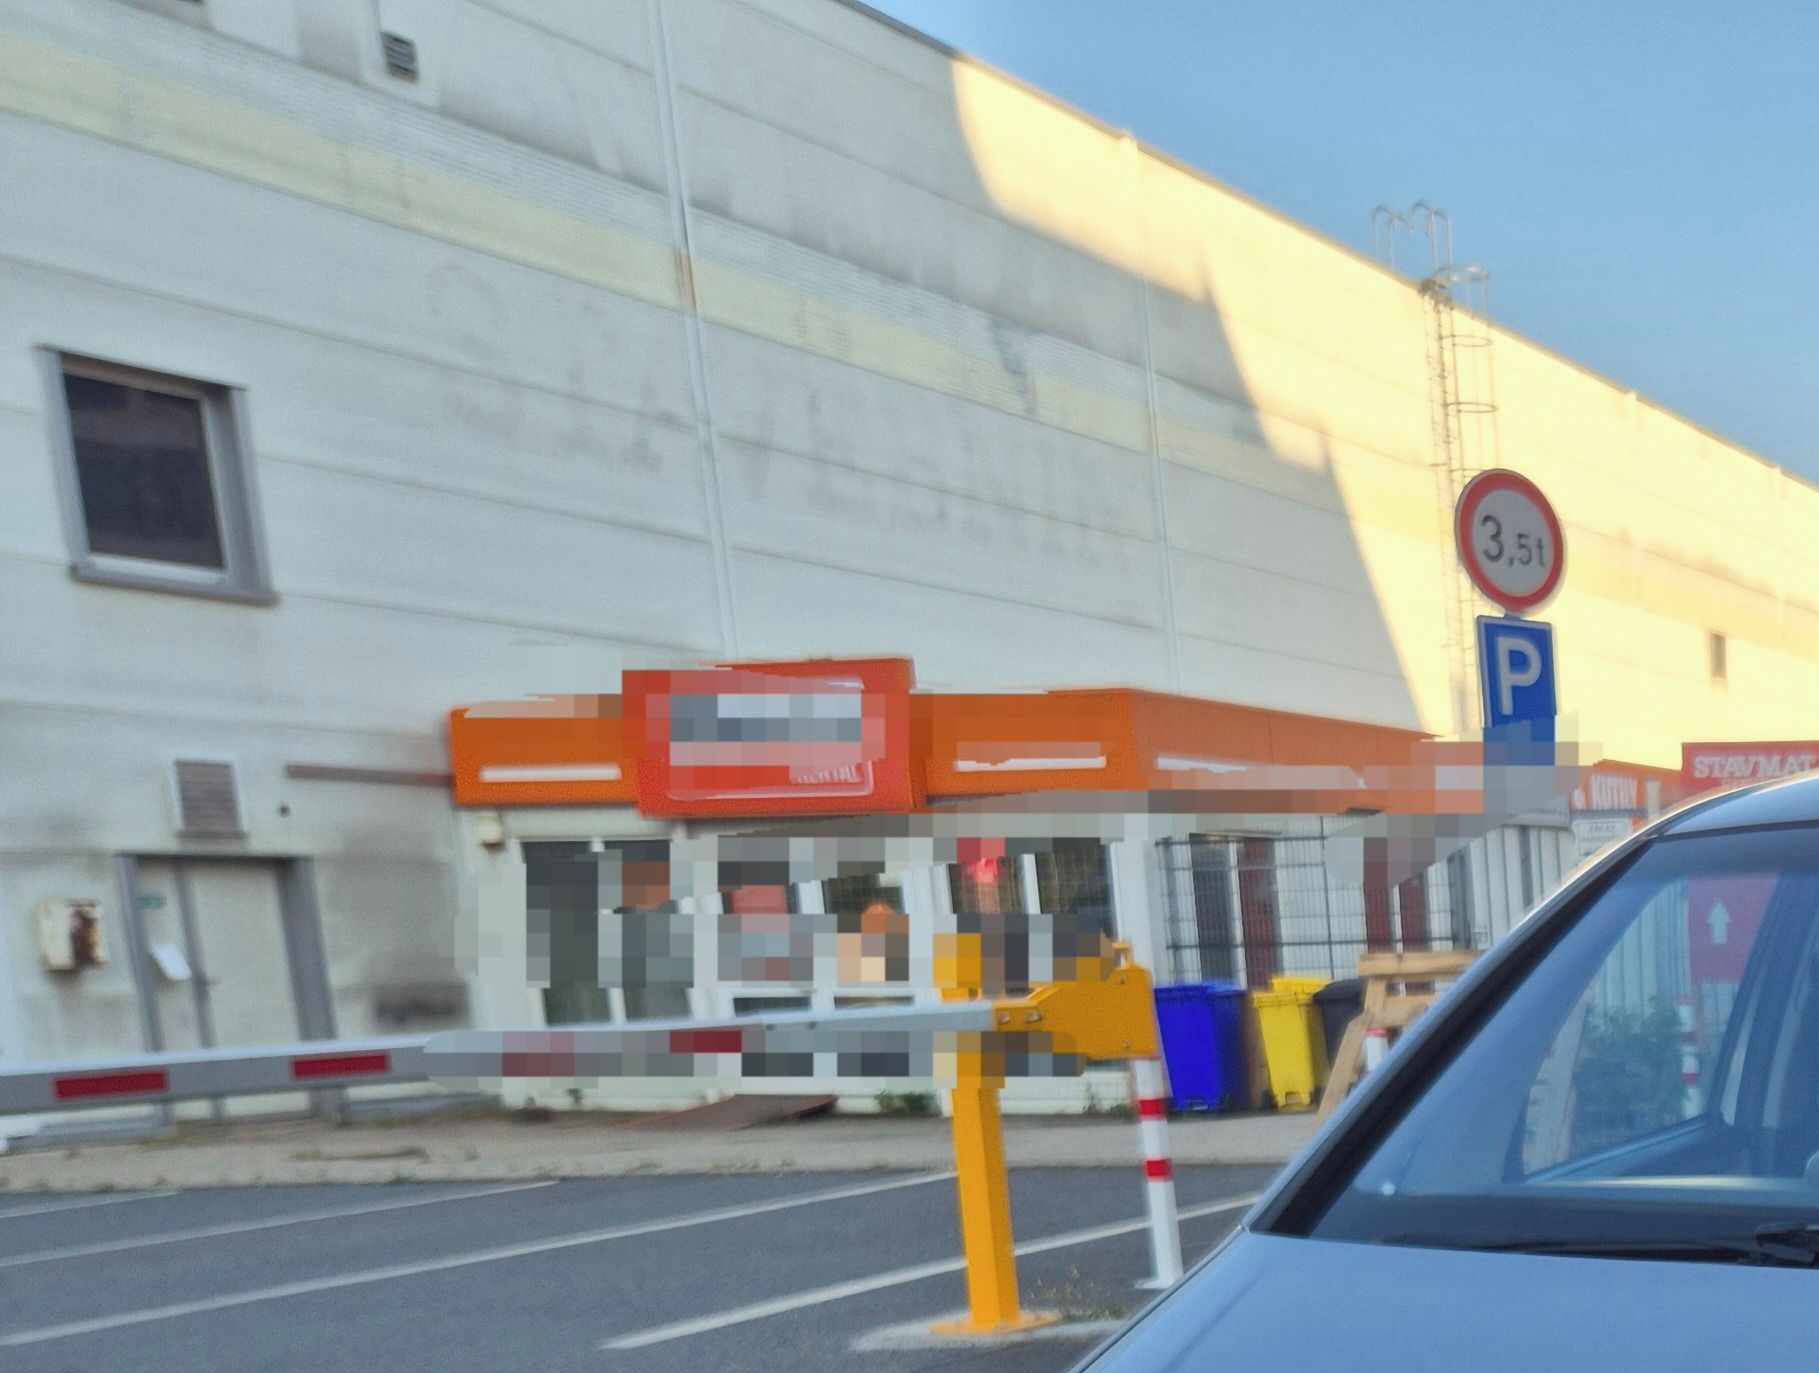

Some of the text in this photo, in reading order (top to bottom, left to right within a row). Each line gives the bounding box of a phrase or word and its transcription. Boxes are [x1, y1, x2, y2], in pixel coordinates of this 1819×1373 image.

[1480, 515, 1546, 567] 3,5t
[1495, 636, 1541, 715] P
[1692, 753, 1816, 778] STAVMAT
